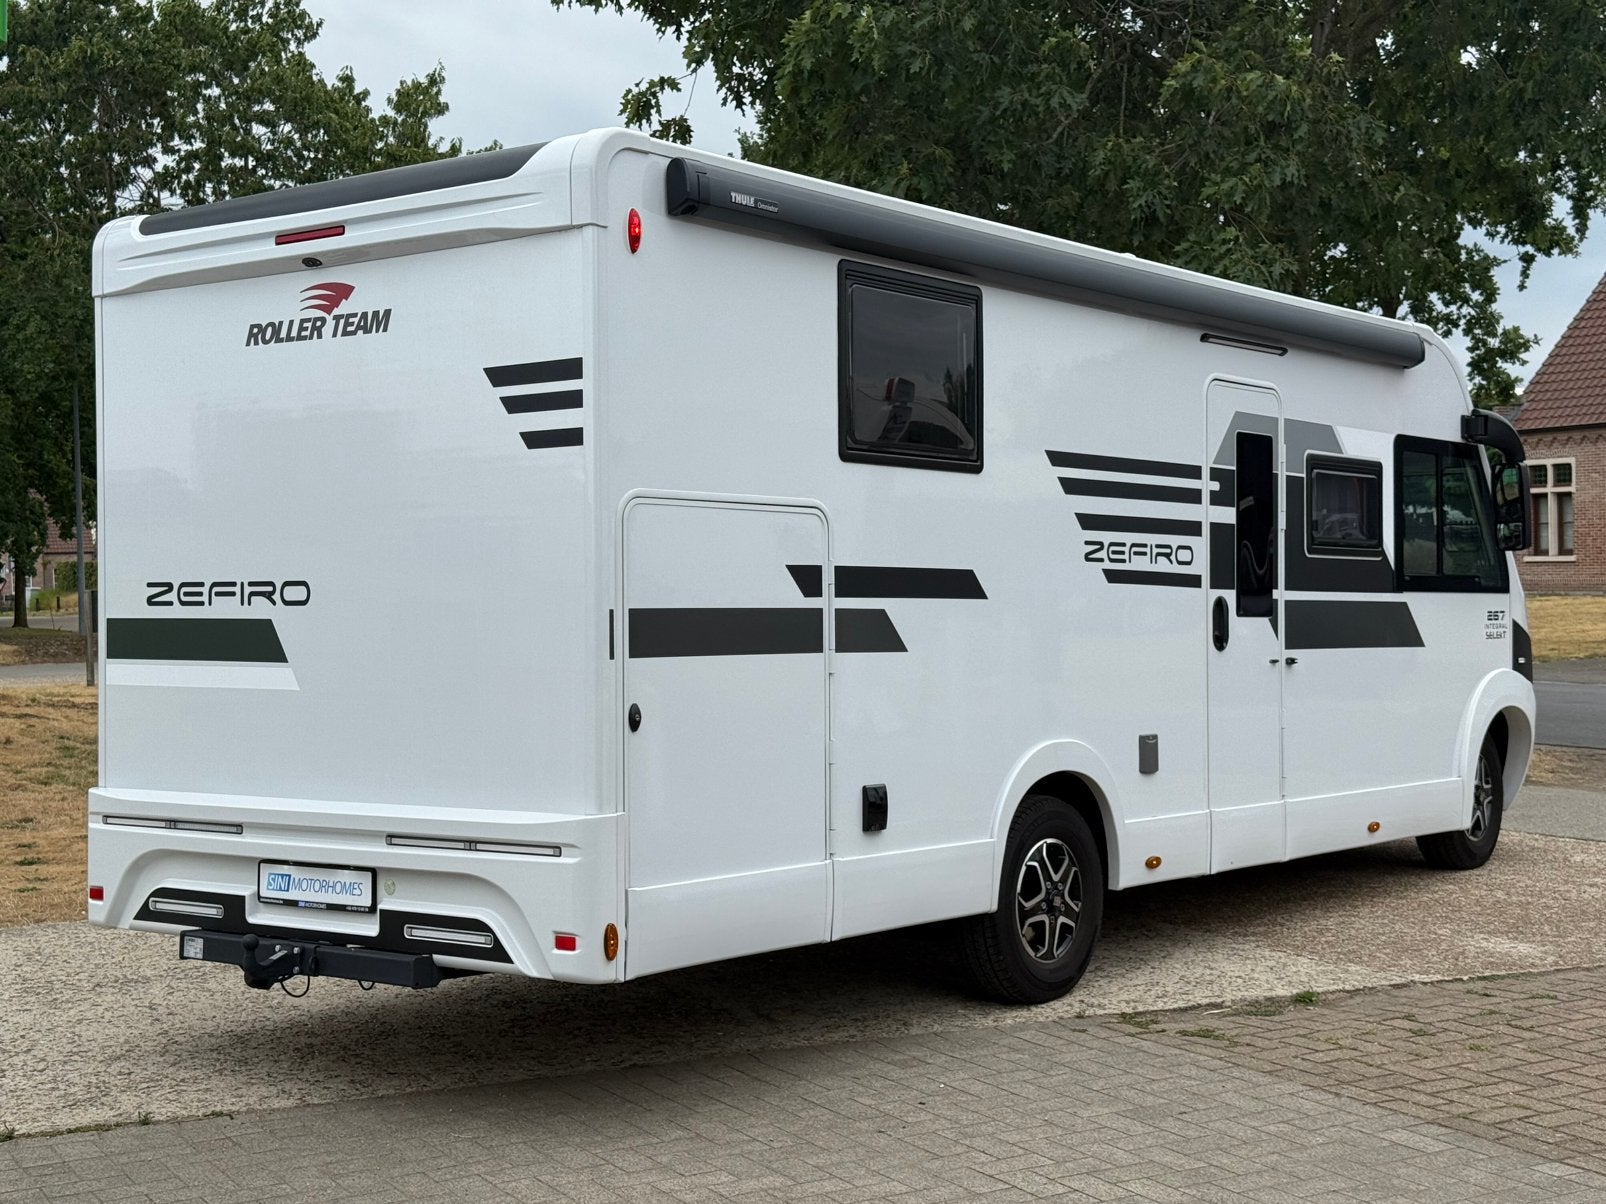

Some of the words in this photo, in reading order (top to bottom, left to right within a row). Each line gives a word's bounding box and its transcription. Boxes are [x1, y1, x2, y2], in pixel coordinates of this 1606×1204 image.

[730, 191, 755, 207] THULE
[245, 316, 327, 347] ROLLER
[332, 308, 392, 338] TEAM
[1084, 540, 1194, 566] ZEFIRO
[146, 580, 311, 607] ZEFIRO
[1487, 610, 1506, 621] 267
[267, 872, 290, 892] SINI
[291, 878, 363, 897] MOTORHOMES
